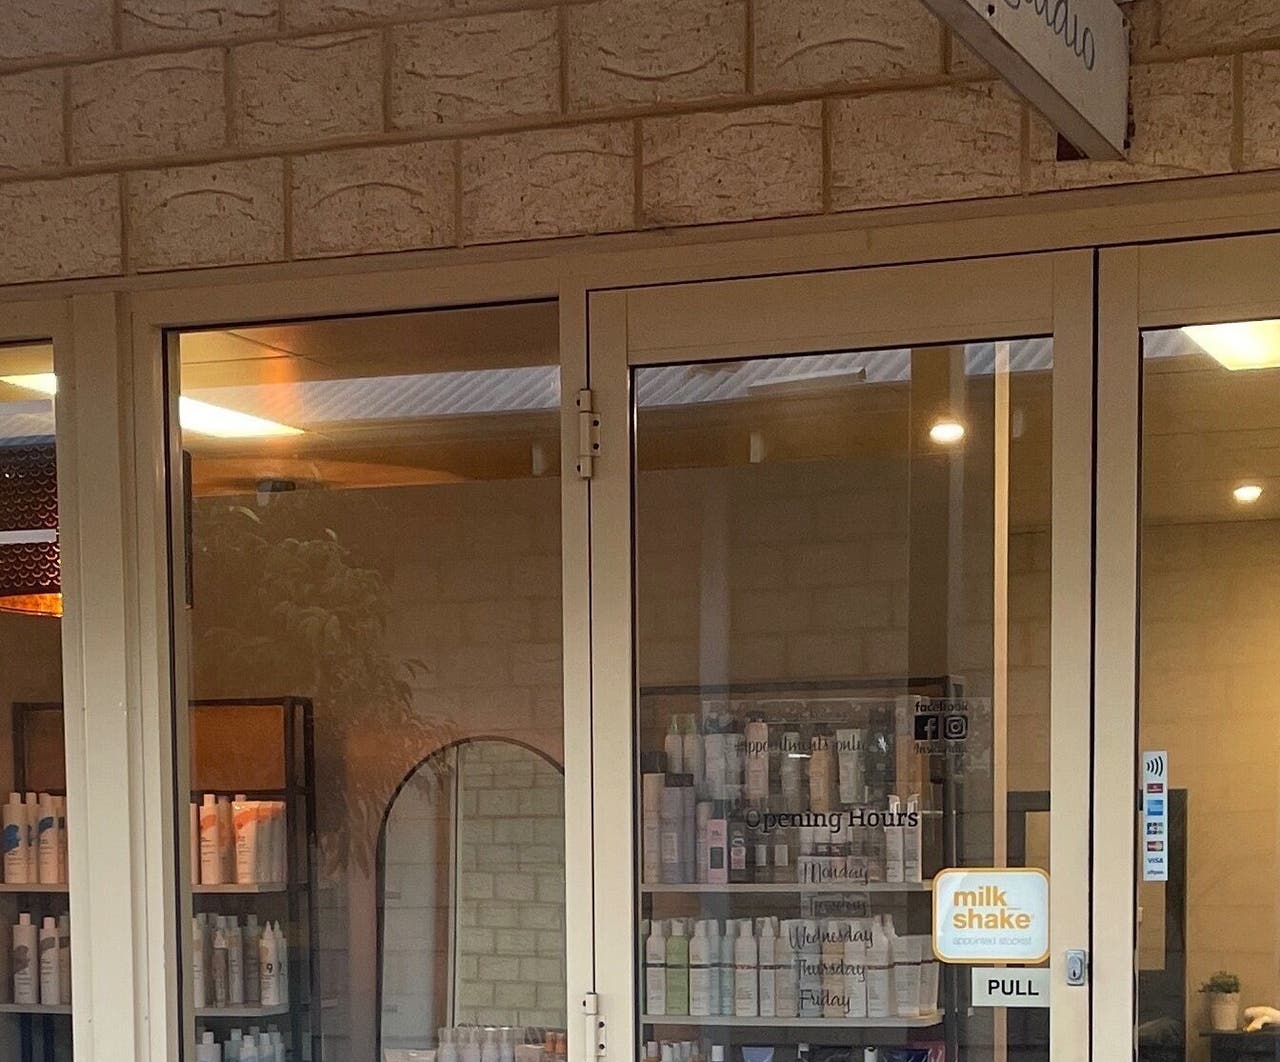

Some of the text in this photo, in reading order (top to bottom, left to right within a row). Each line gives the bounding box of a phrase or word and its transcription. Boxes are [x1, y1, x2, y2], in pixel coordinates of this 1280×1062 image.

[1004, 0, 1095, 71] udio
[745, 809, 919, 833] Opening Hours
[802, 862, 870, 885] Monday
[952, 908, 1032, 930] shake
[788, 924, 874, 950] Wednesday
[793, 958, 866, 983] Thursday
[987, 979, 1040, 996] PULL
[799, 988, 851, 1014] Friday
